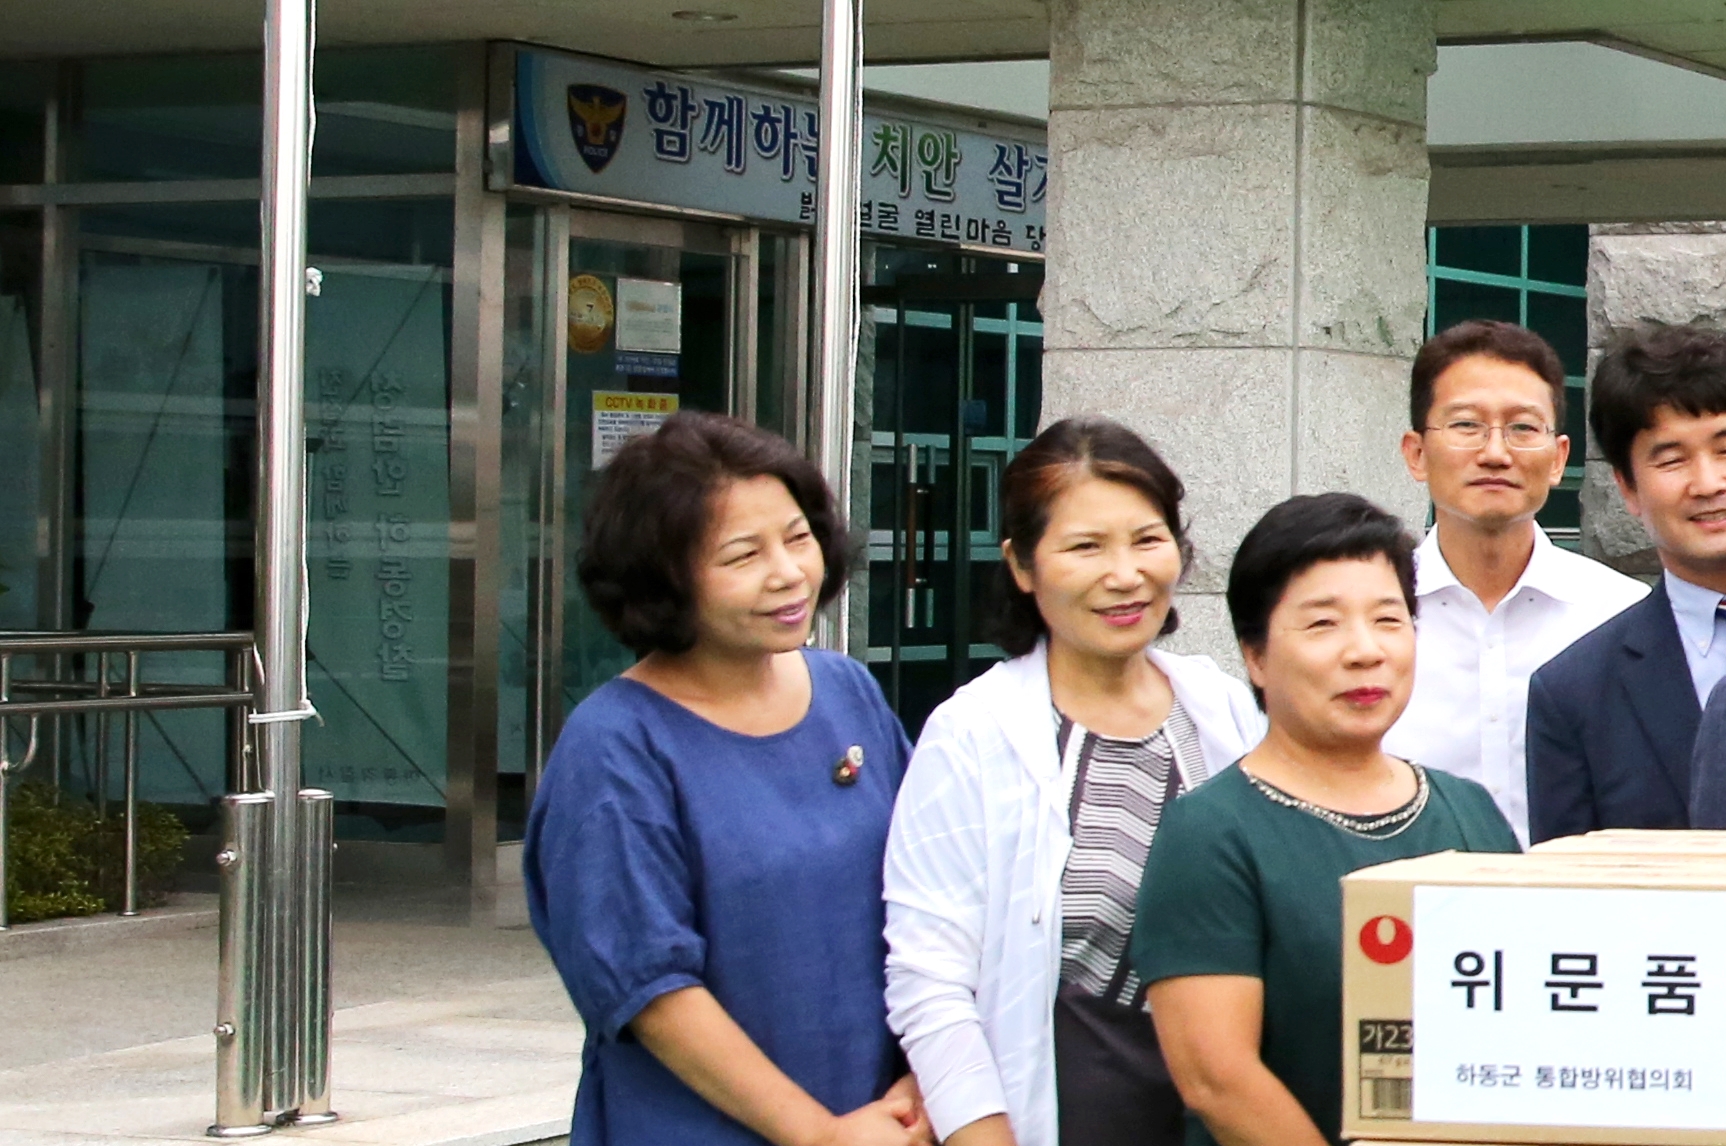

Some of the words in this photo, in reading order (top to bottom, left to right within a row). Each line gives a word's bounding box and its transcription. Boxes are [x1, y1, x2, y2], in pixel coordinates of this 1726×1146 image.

[871, 124, 960, 201] 치안
[605, 396, 631, 409] CCTV
[1364, 1023, 1413, 1051] 가23
[1456, 1063, 1521, 1089] 하동군
[1535, 1066, 1693, 1091] 통합방위협의회
